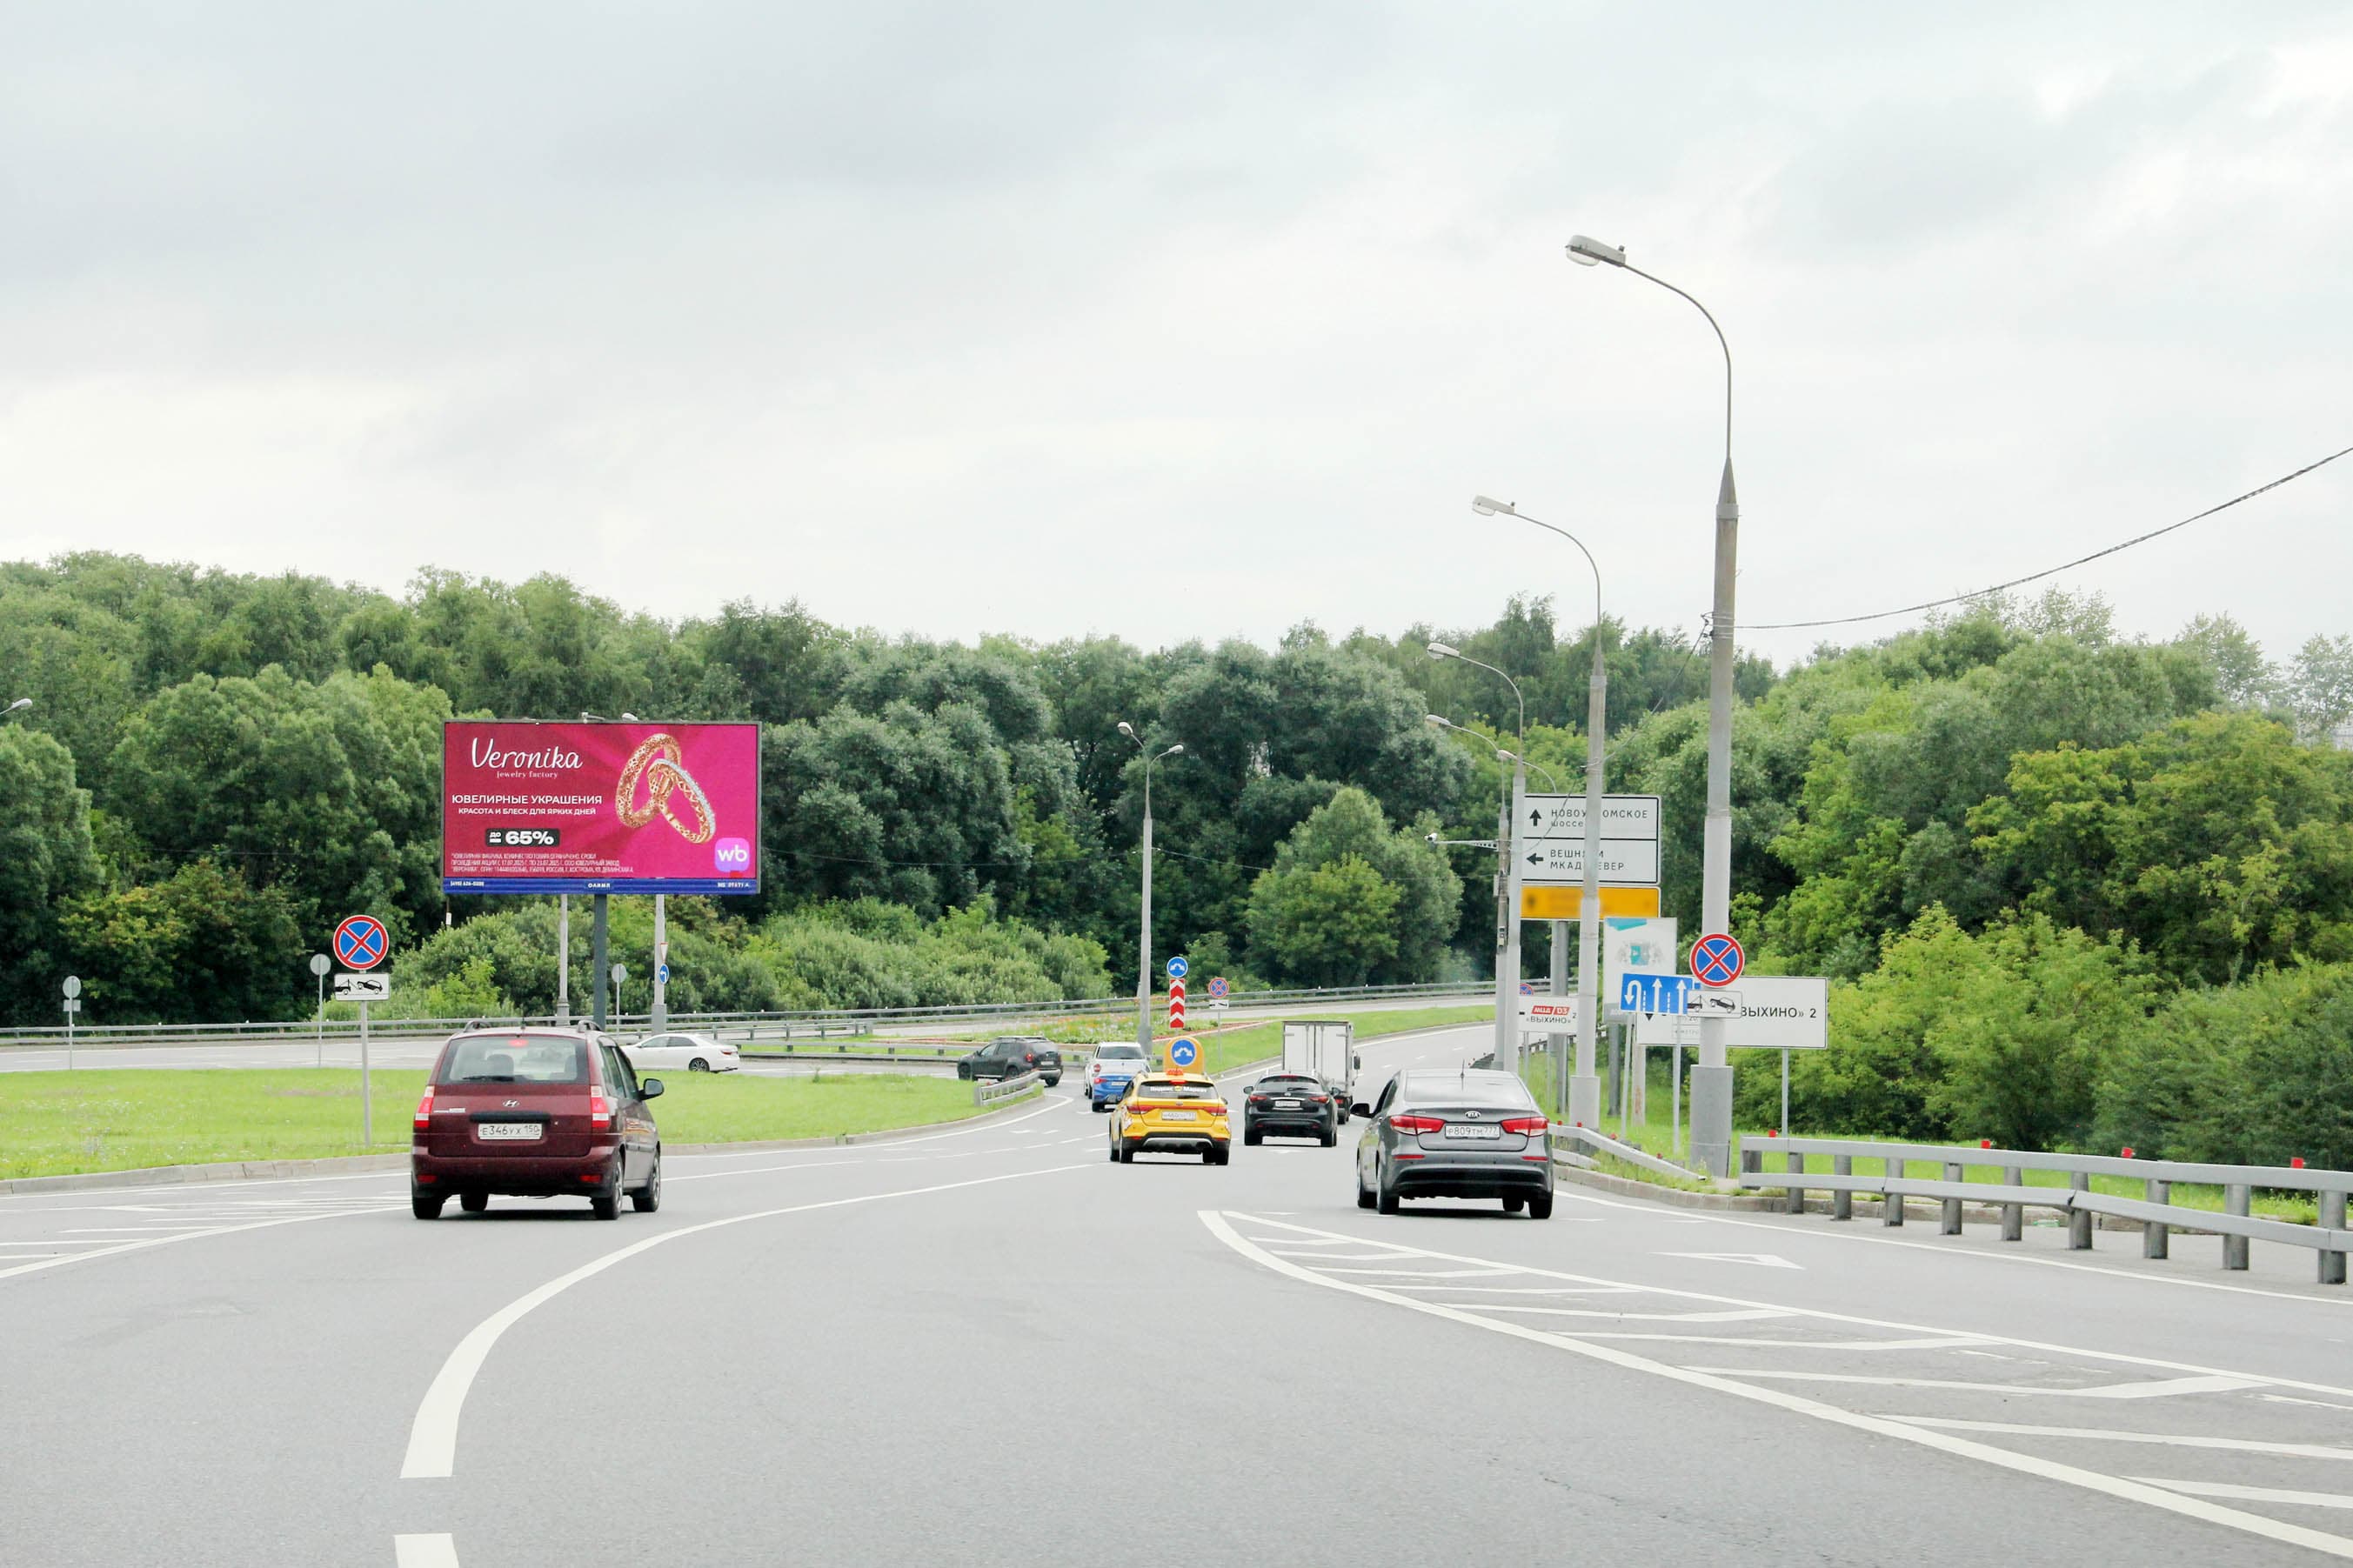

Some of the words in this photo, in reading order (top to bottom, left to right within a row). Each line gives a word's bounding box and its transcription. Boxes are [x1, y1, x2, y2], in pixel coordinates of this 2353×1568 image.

[471, 737, 584, 769] Veronika
[529, 771, 558, 779] factory
[451, 795, 528, 804] ЮВЕЛИРНЫЕ
[531, 795, 602, 804] УКРАШЕНИЯ
[573, 807, 596, 816] ДНЕЙ
[1551, 809, 1648, 818] НОВОУОМСКОЕ
[505, 831, 555, 845] 65%
[717, 844, 748, 862] wb
[1550, 849, 1604, 857] ВЕШНИ
[1550, 861, 1582, 871] МКАД
[1598, 861, 1625, 871] ЕВЕР
[1809, 1007, 1817, 1018] 2
